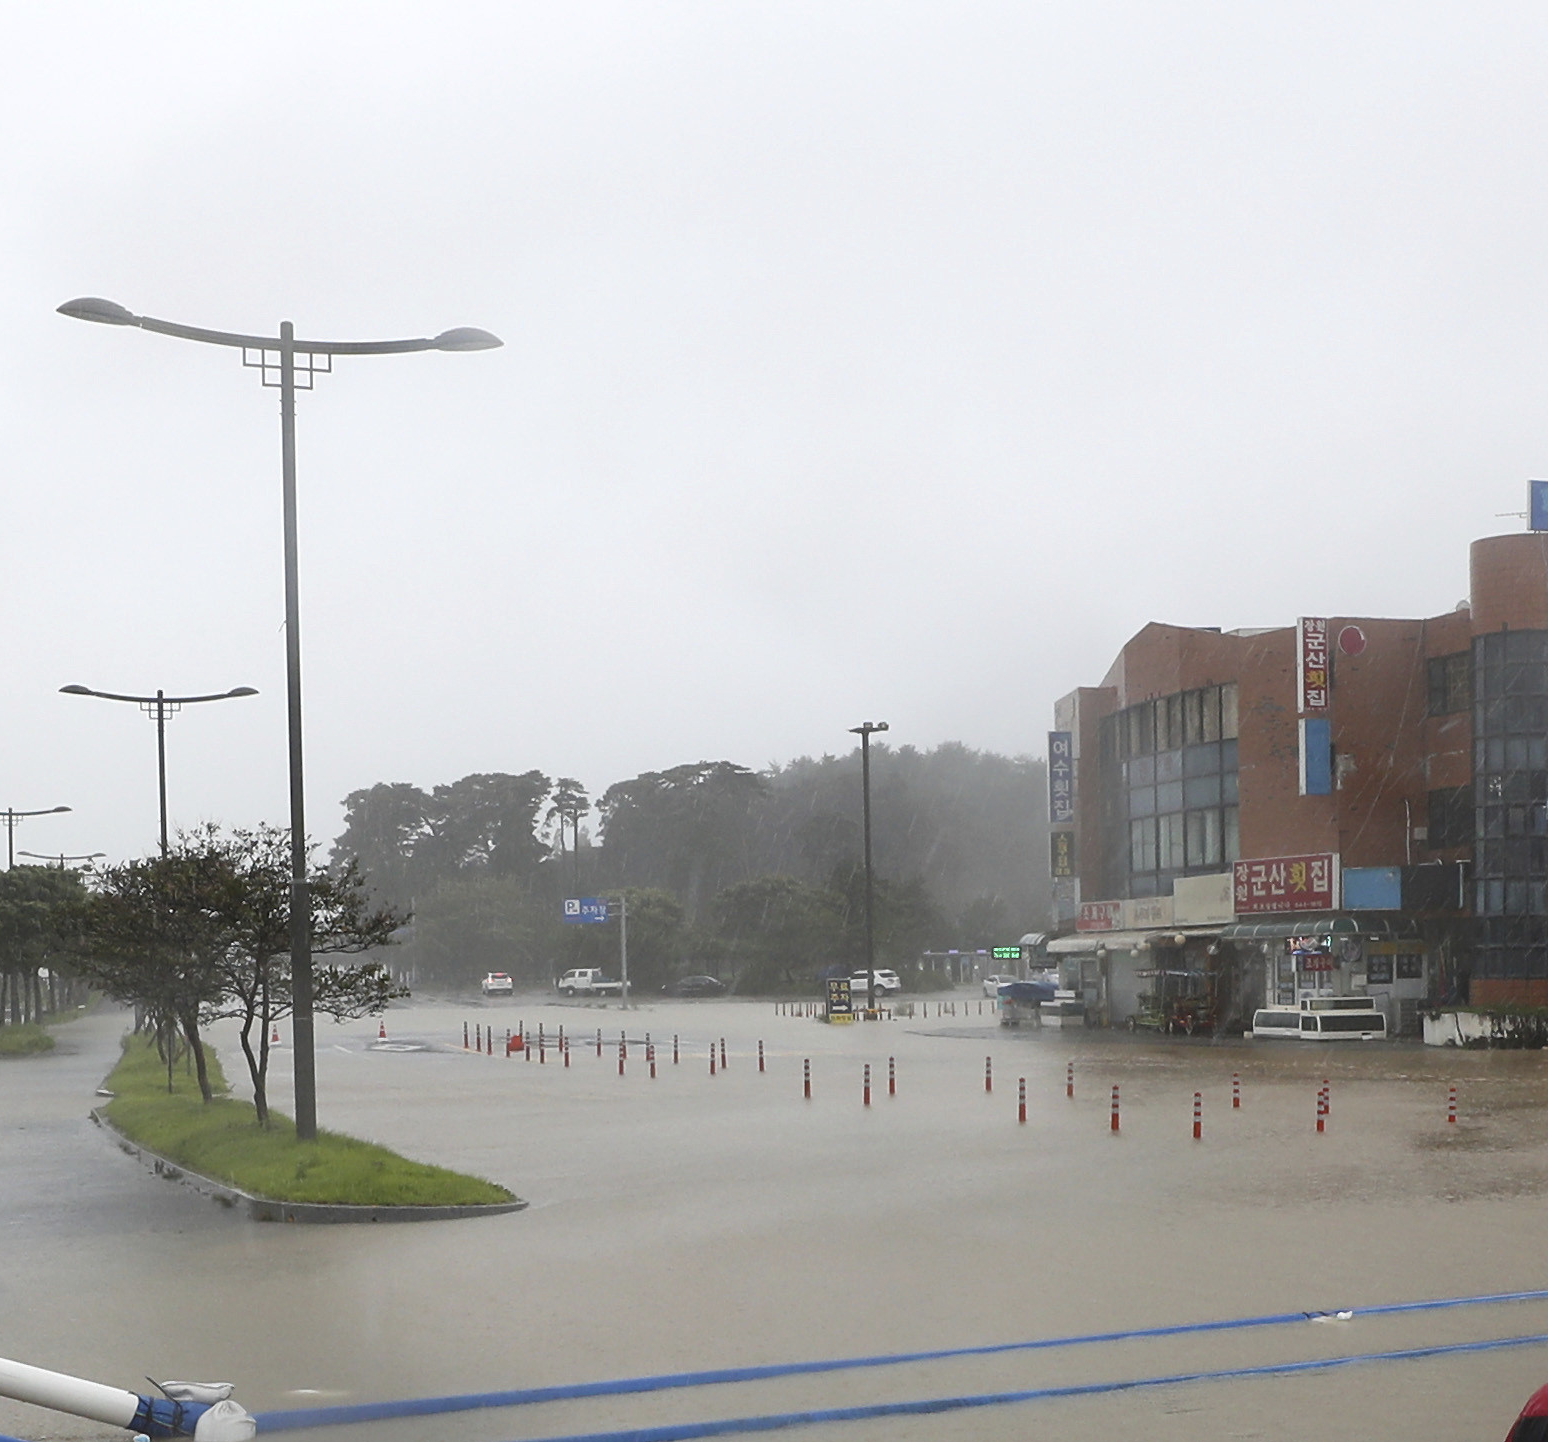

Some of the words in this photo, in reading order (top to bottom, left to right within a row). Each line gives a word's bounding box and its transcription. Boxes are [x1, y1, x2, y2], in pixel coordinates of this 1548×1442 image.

[1305, 633, 1326, 707] 군산횟집
[1053, 740, 1073, 820] 여수횟집
[1250, 858, 1329, 897] 군산횟집
